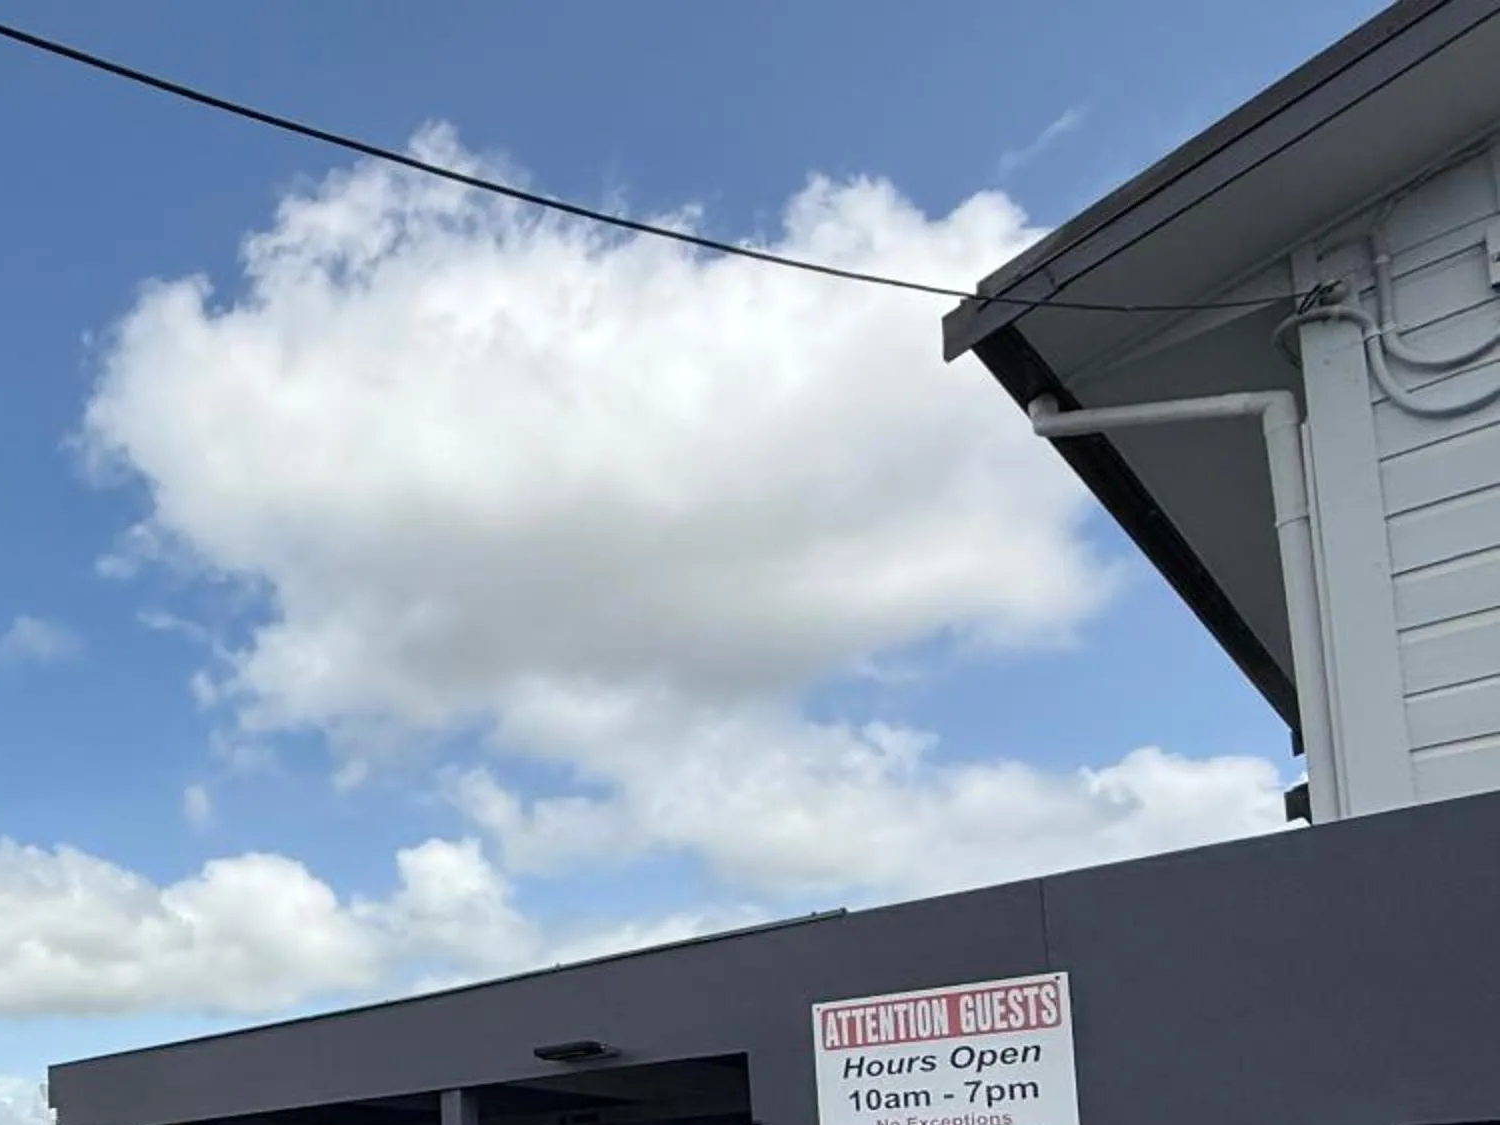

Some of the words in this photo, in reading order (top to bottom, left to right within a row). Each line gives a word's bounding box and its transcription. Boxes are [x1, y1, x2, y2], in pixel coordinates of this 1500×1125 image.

[825, 998, 949, 1047] ATTENTION
[960, 984, 1058, 1033] GUESTS
[843, 1056, 937, 1079] Hours
[950, 1044, 1042, 1072] Open
[849, 1089, 931, 1111] 10am
[963, 1080, 1039, 1108] 7pm
